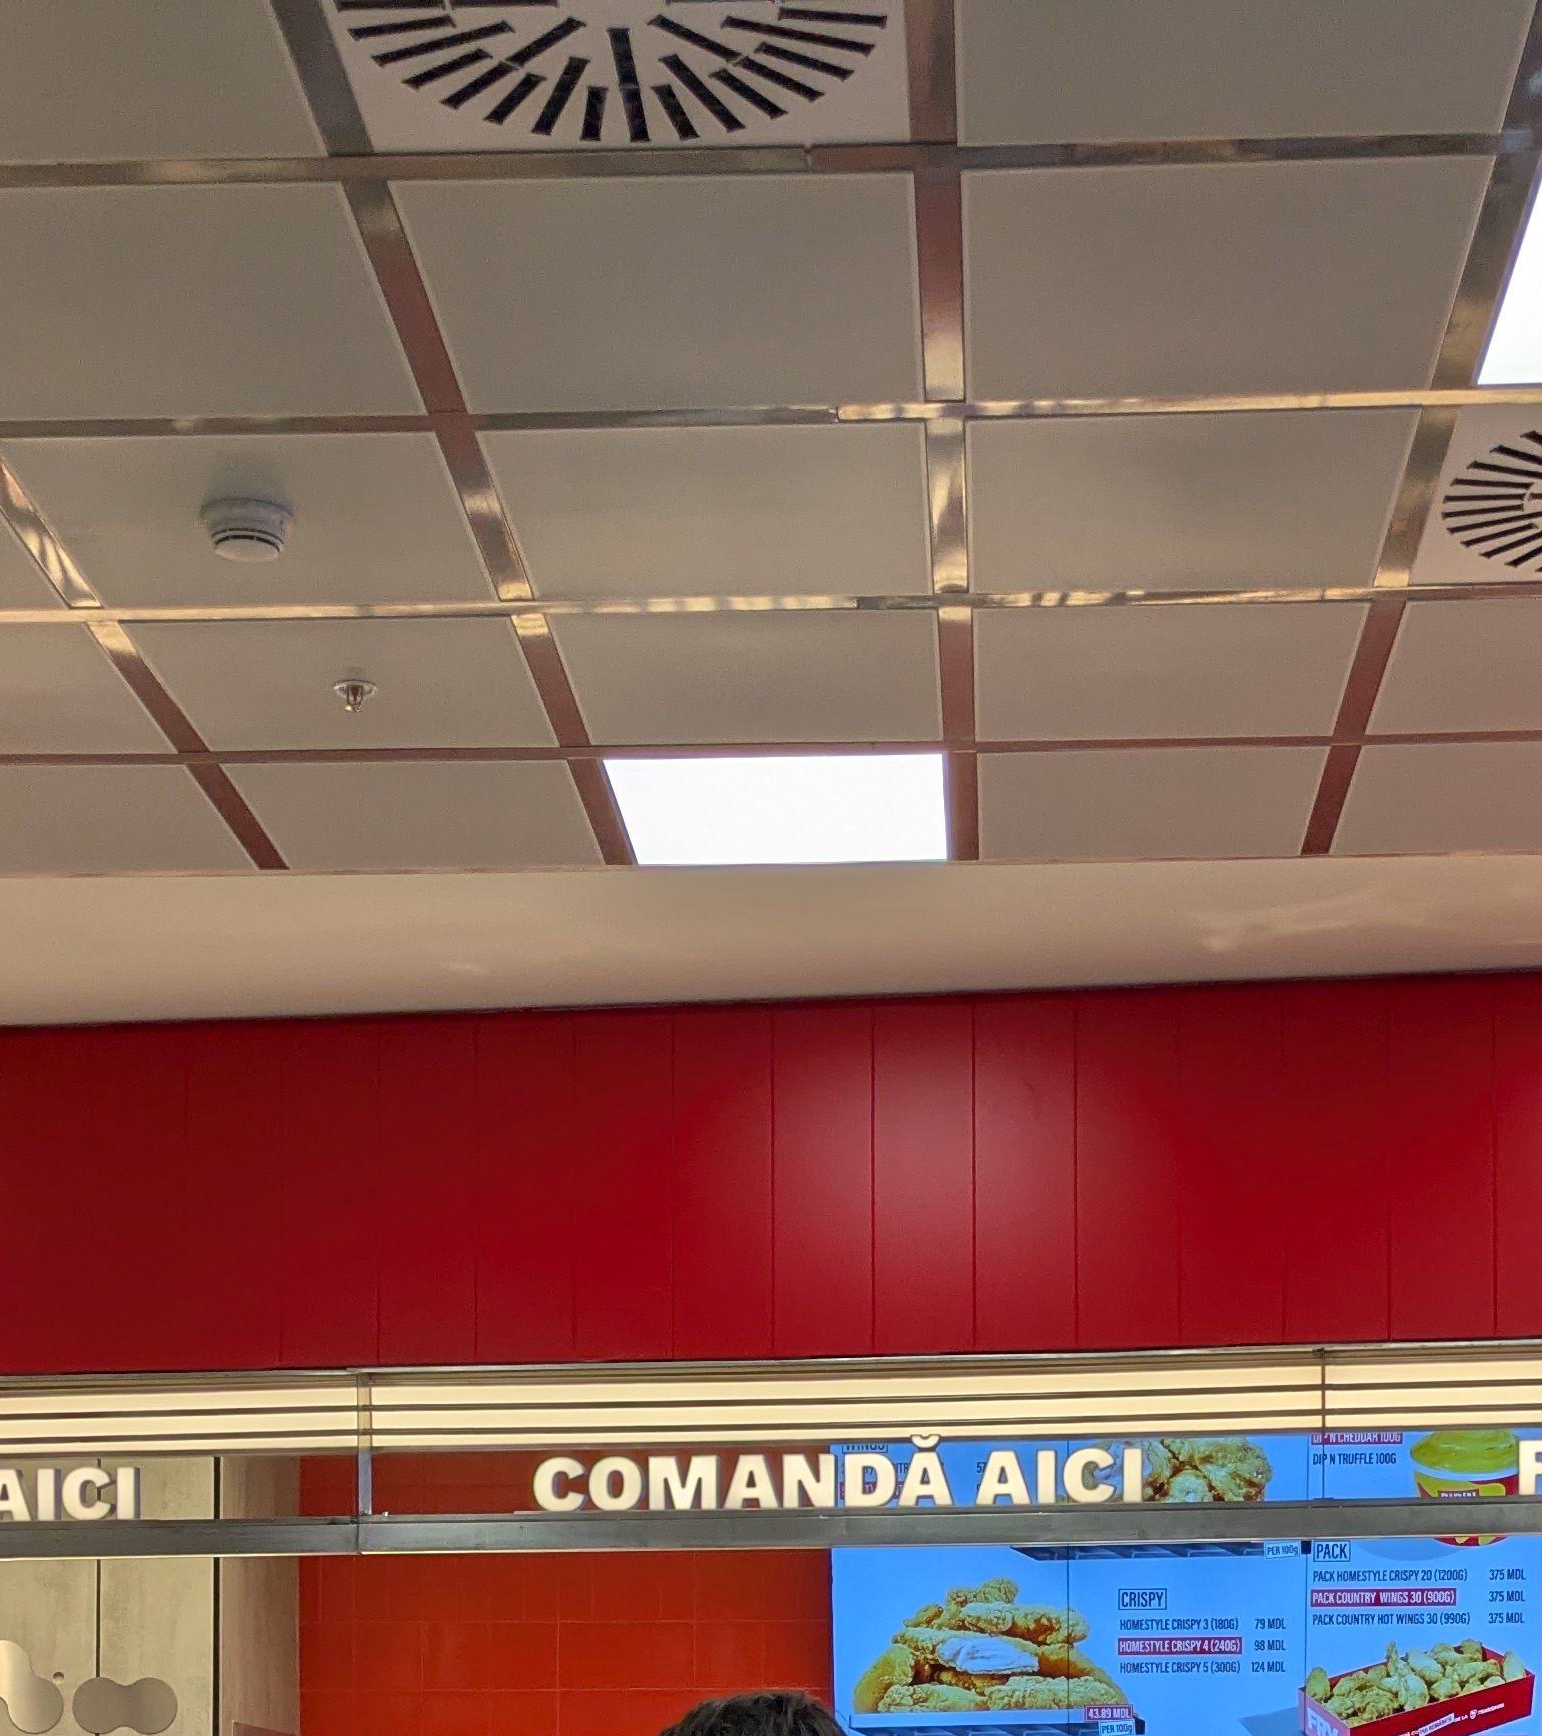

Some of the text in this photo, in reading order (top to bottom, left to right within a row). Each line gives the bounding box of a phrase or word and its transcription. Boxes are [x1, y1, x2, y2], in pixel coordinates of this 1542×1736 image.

[1338, 1453, 1374, 1464] TRUFFLE
[1376, 1452, 1397, 1464] 100G
[532, 1434, 1143, 1512] COMANDĂ AICI
[1316, 1543, 1347, 1559] PACK
[1313, 1571, 1335, 1582] PACK
[1337, 1570, 1387, 1582] HOMESTYLE
[1389, 1570, 1419, 1581] CRISPY
[1421, 1570, 1432, 1580] 20
[1489, 1569, 1505, 1580] 375
[1507, 1569, 1526, 1580] MDL
[1121, 1591, 1164, 1608] CRISPY
[1312, 1591, 1525, 1604] PACK COUNTRY WINGS 30 (900G) 375 MDL
[1120, 1618, 1286, 1630] HOMESTYLE CRISPY 3 (180G) 79 MDL
[1312, 1614, 1334, 1625] PACK
[1336, 1613, 1375, 1625] COUNTRY
[1377, 1613, 1394, 1624] HOT
[1396, 1613, 1425, 1624] WINGS
[1426, 1613, 1438, 1624] 30
[1488, 1613, 1504, 1624] 375
[1506, 1613, 1525, 1624] MDL
[1120, 1639, 1286, 1652] HOMESTYLE CRISPY 4 (240G) 98 MDL
[1120, 1661, 1286, 1673] HOMESTYLE CRISPY 5 (300G) 124 MDL
[1088, 1707, 1130, 1718] 43.89 MDL
[1101, 1725, 1115, 1734] PER
